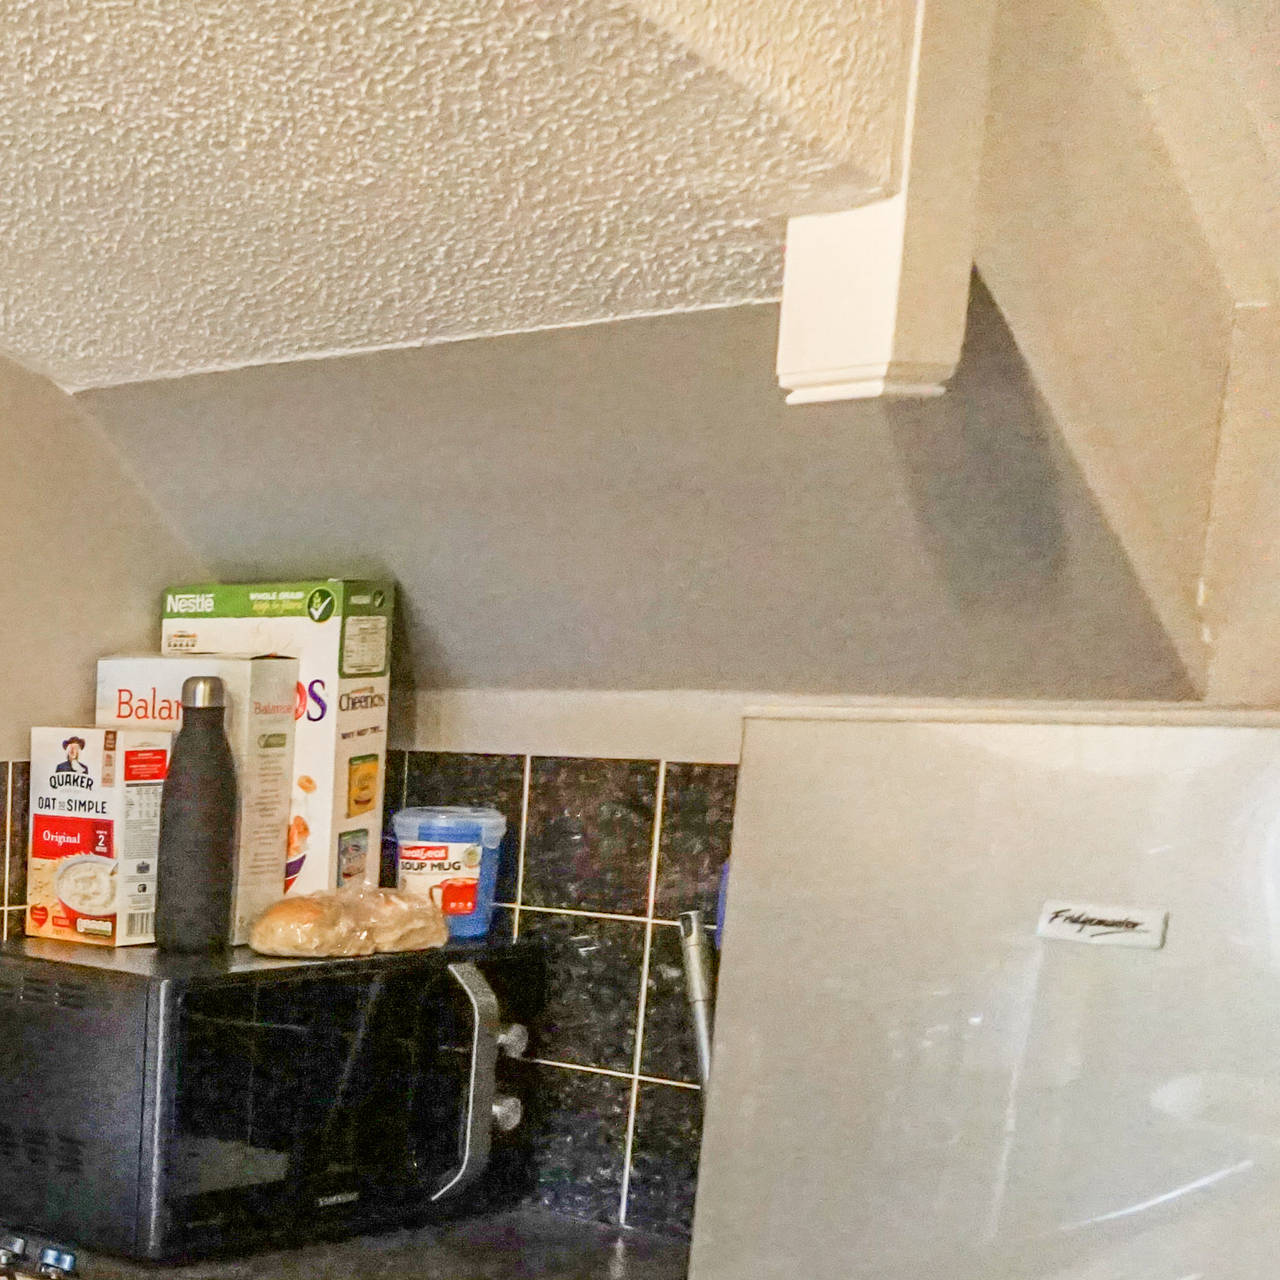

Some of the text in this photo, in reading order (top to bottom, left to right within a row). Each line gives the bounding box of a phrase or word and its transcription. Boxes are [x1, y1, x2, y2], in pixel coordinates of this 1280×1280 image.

[49, 774, 94, 791] QUAKER
[38, 796, 57, 810] OAT
[67, 798, 108, 814] SIMPLE
[43, 830, 81, 847] Original
[98, 834, 105, 847] 2
[400, 861, 461, 871] SOUP MUG
